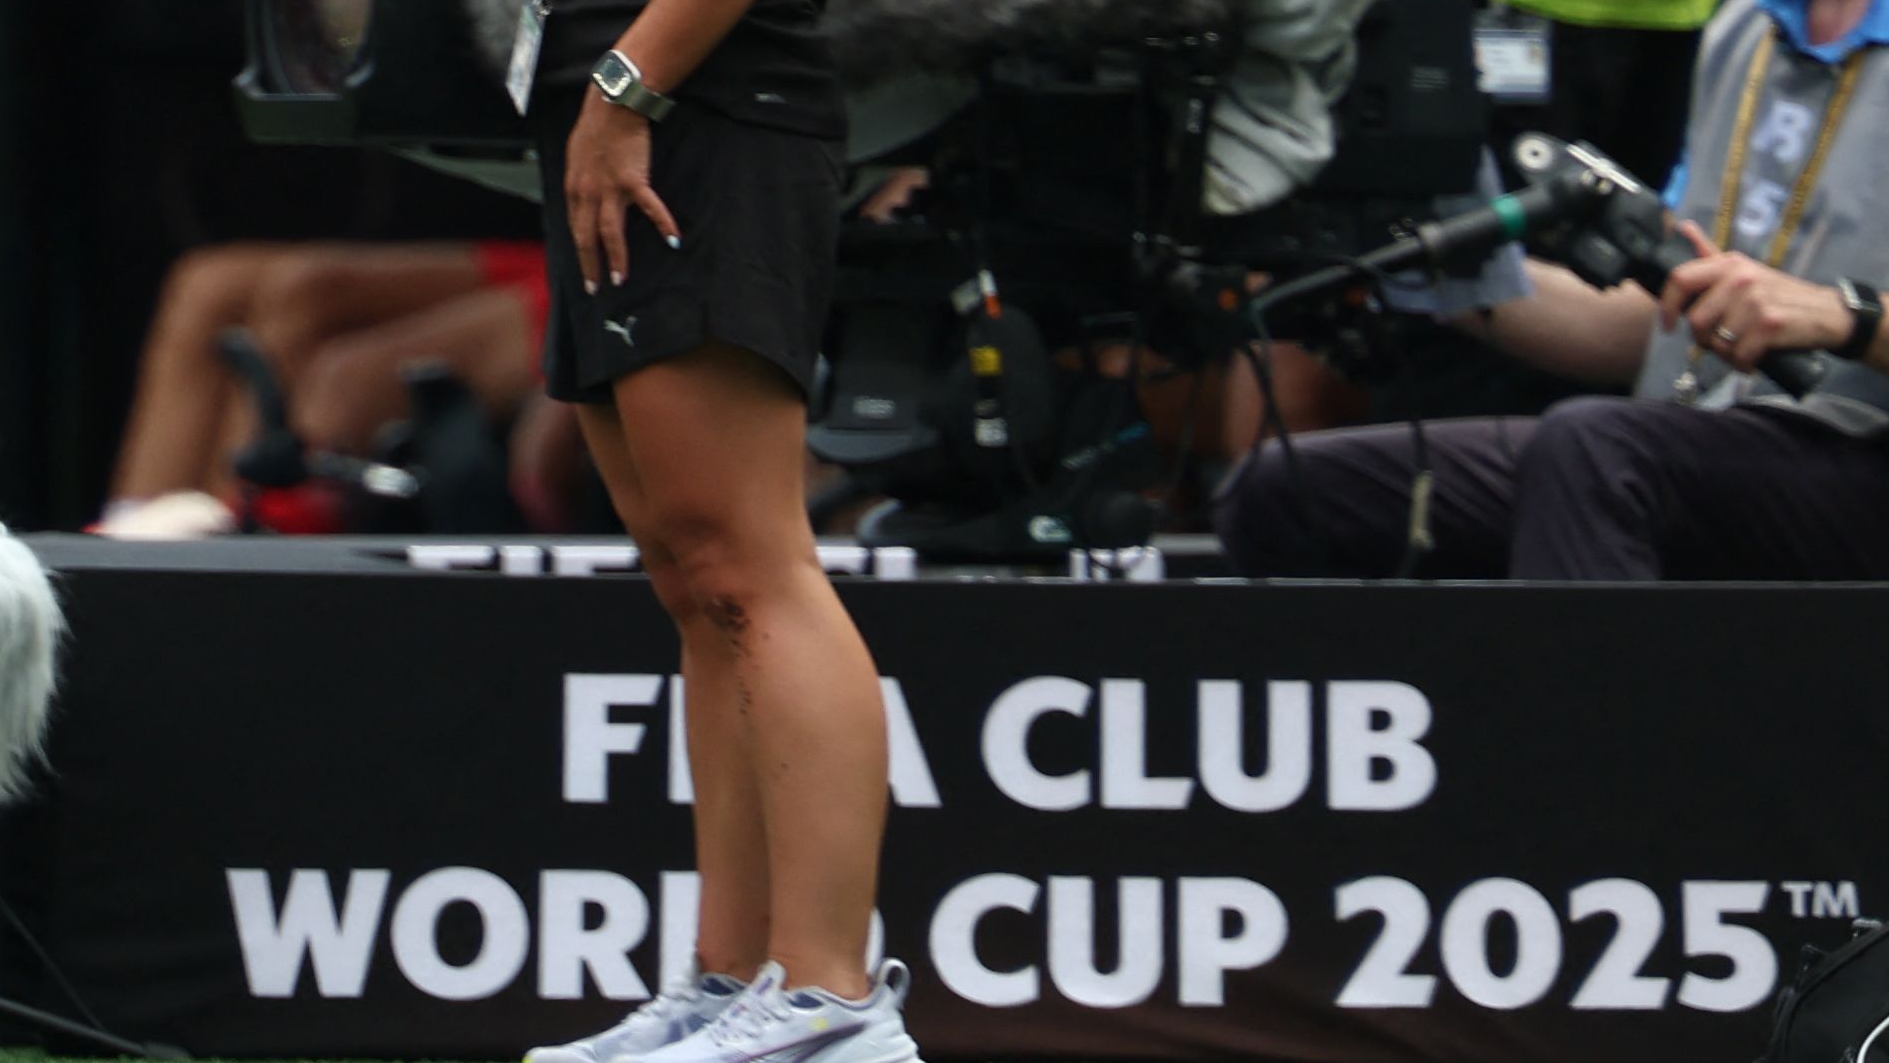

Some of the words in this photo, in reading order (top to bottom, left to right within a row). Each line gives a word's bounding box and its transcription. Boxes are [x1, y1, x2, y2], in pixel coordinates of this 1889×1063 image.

[563, 673, 942, 808] FI
[982, 675, 1438, 813] CLUB
[226, 866, 886, 1001] WORL
[929, 872, 1291, 1010] CUP
[1335, 875, 1780, 1013] 2025
